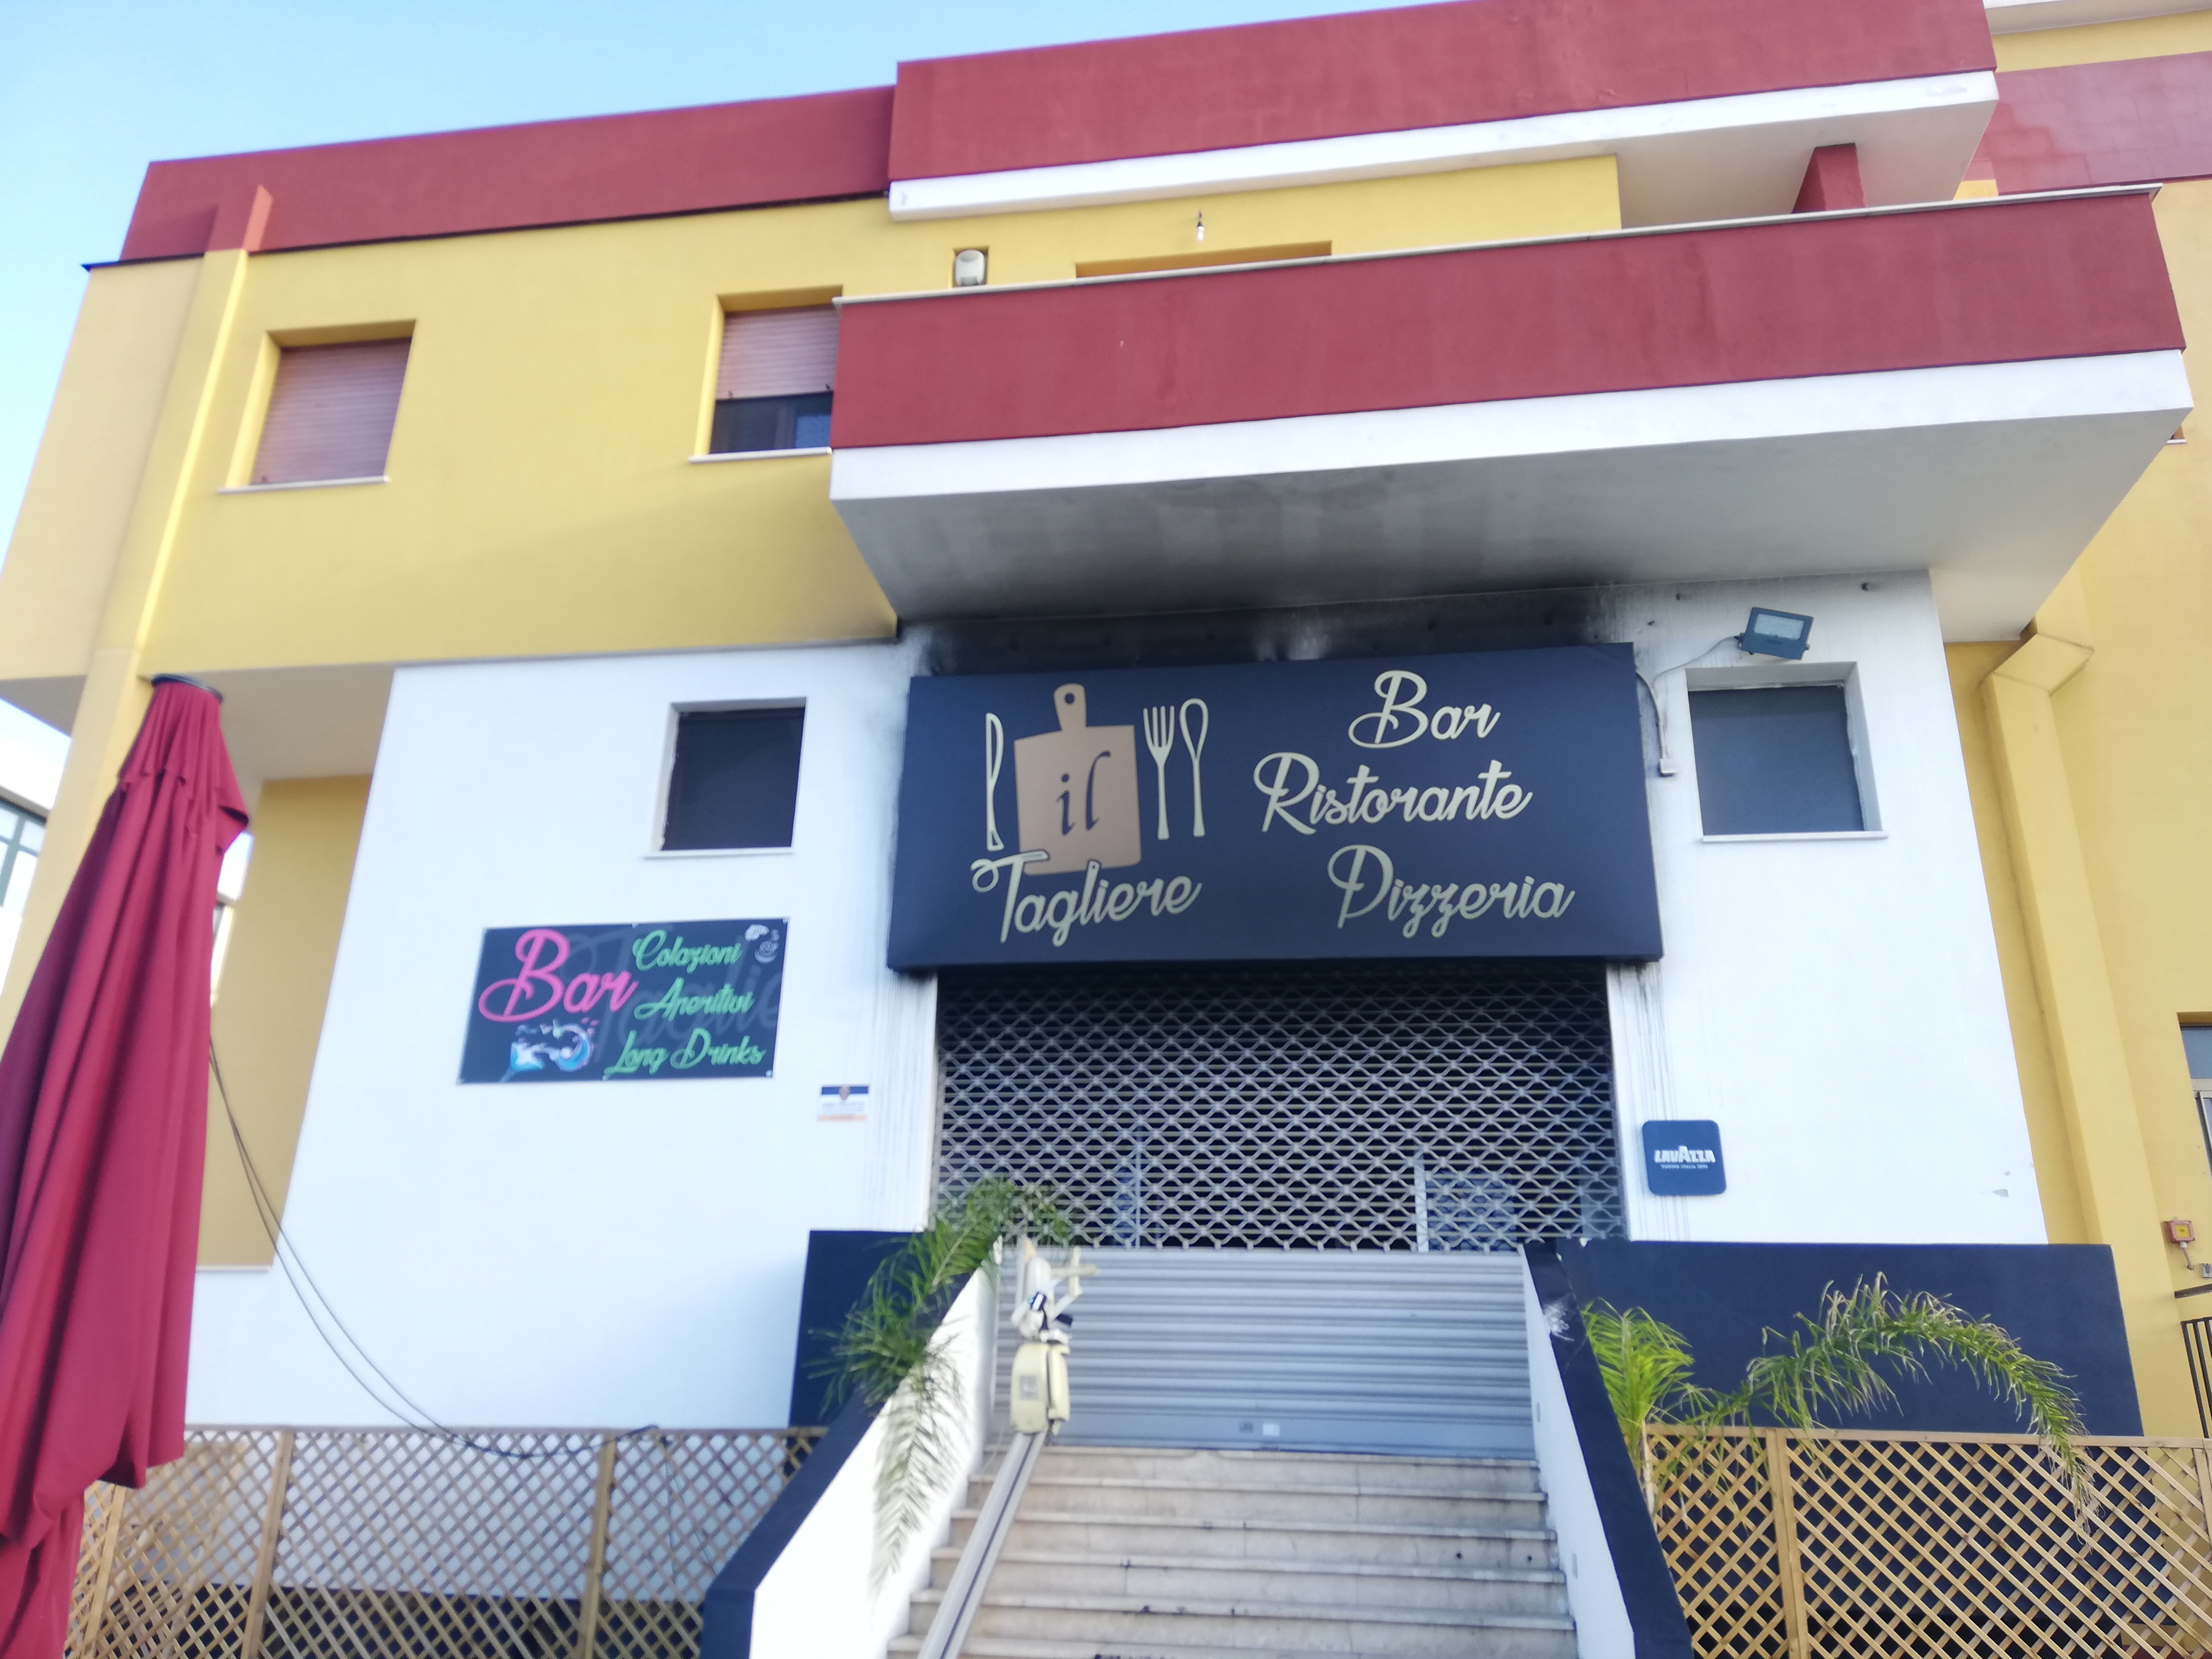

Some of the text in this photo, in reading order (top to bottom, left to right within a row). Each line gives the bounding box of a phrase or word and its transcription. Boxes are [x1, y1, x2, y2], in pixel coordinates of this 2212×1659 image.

[1348, 670, 1501, 749] Bar
[1056, 750, 1111, 836] il
[1253, 752, 1533, 835] Ristorante
[971, 849, 1202, 947] Tagliere
[1327, 844, 1575, 938] Pizzeria
[478, 928, 639, 1022] Bar
[632, 929, 743, 974] Colazioni
[634, 977, 756, 1021] Aperitivi
[603, 1028, 767, 1074] Long Drinks
[1654, 1145, 1716, 1163] LAVAZZA
